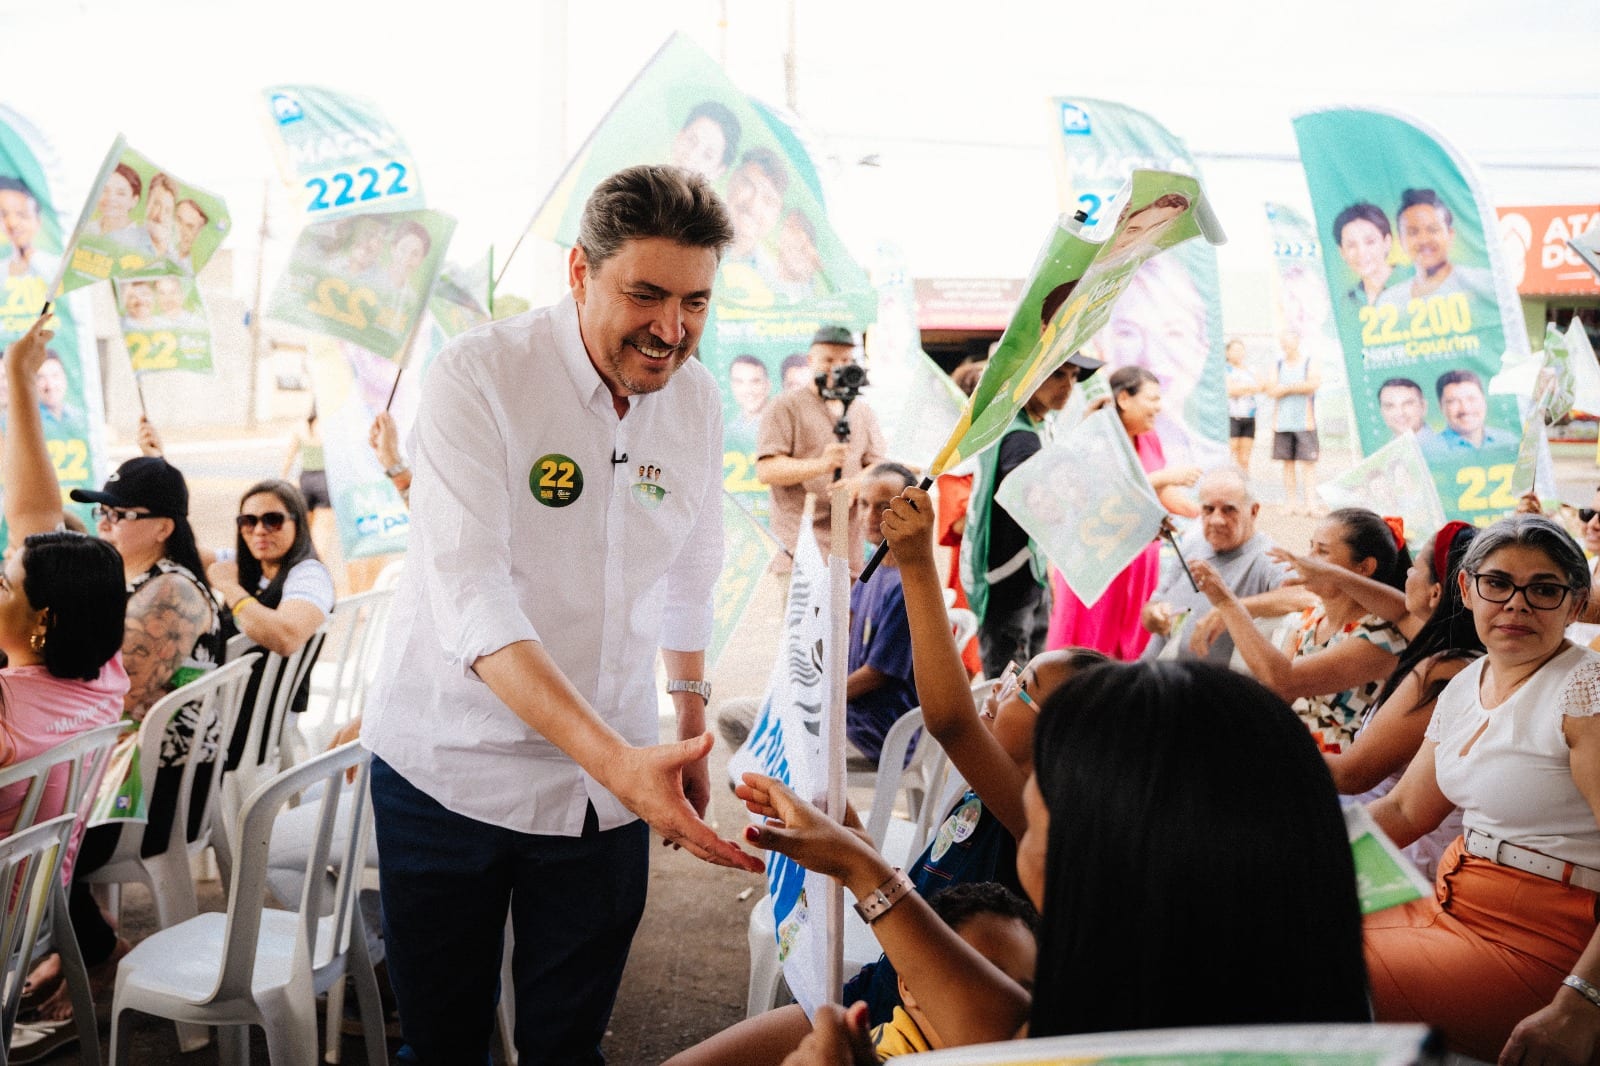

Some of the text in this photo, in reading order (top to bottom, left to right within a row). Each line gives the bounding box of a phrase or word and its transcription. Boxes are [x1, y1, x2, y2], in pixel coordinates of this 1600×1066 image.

[305, 161, 409, 212] 2222
[1359, 292, 1472, 347] 22.200
[125, 330, 178, 371] 22
[46, 438, 89, 481] 22
[539, 460, 575, 488] 22
[1455, 464, 1520, 511] 22
